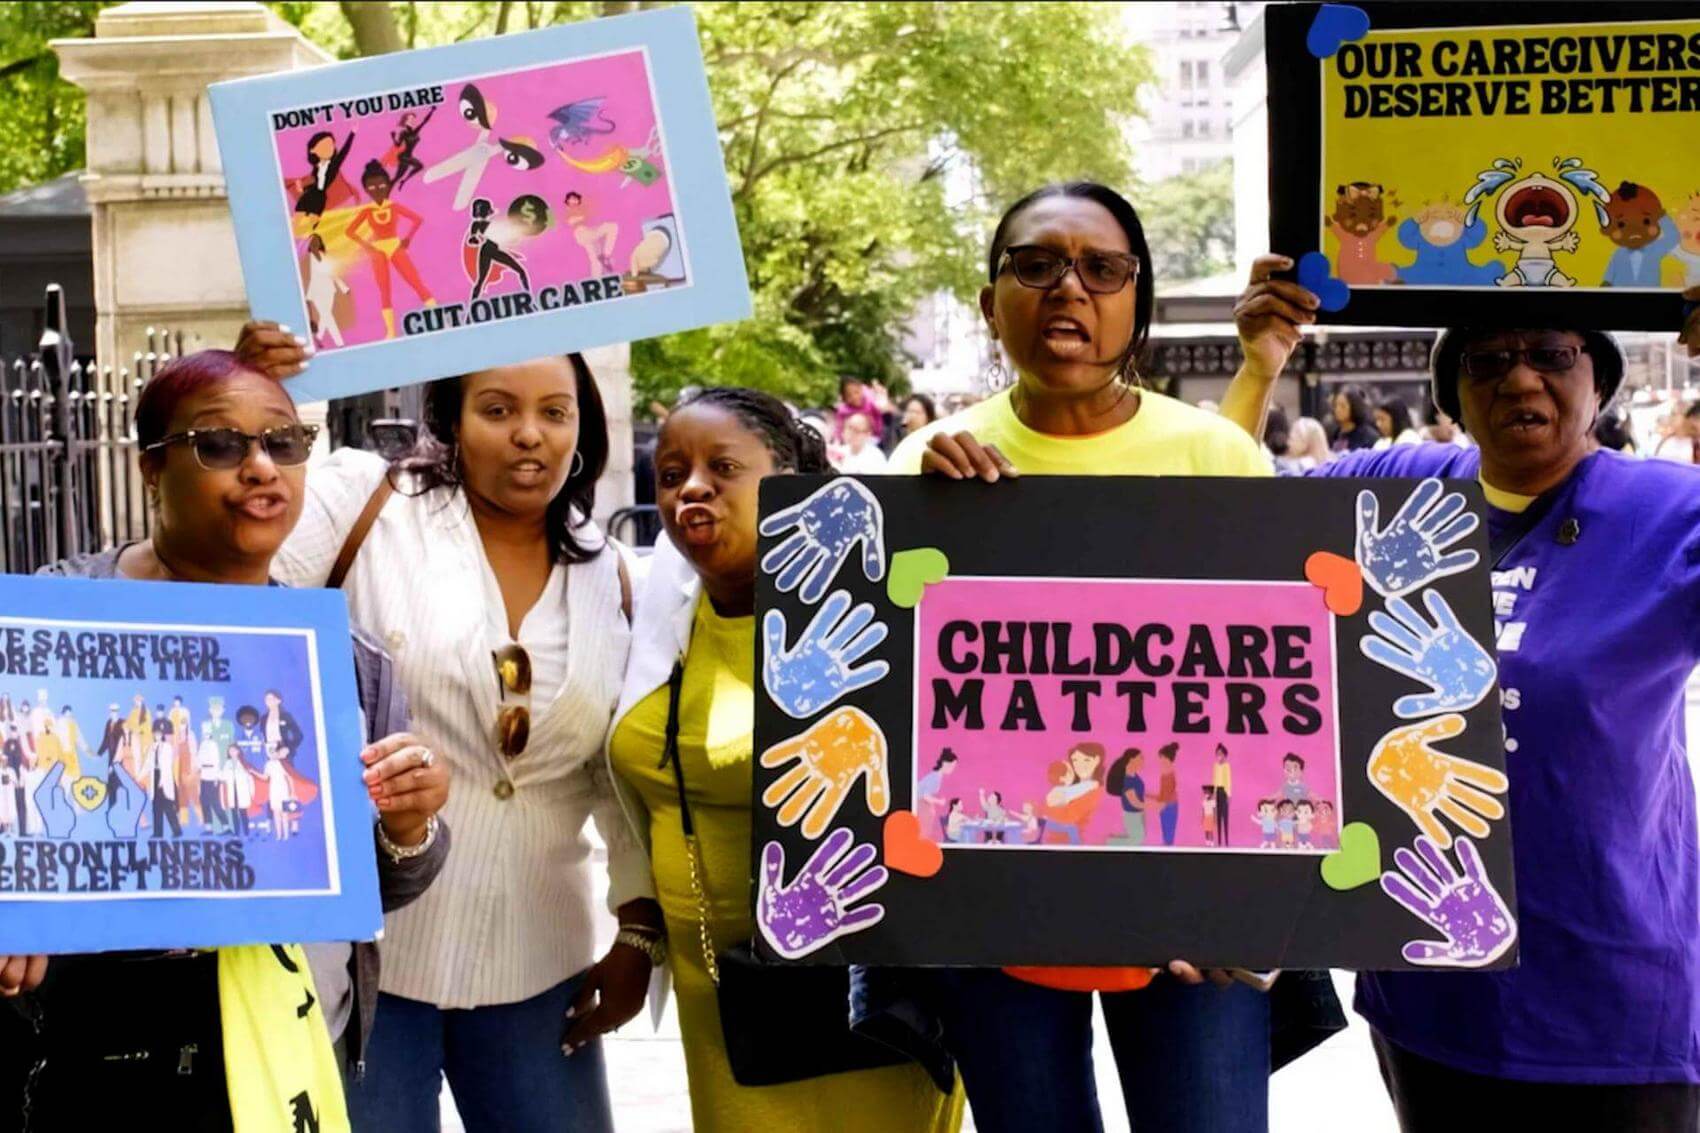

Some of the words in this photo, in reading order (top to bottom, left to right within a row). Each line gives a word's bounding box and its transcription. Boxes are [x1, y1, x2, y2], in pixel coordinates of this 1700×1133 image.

[1336, 41, 1422, 80] OUR
[272, 104, 334, 131] DON'T
[340, 96, 384, 119] YOU
[388, 86, 445, 111] DARE
[1343, 80, 1531, 119] DESERVE
[1540, 76, 1700, 115] BETTER
[403, 304, 464, 337] CUT
[470, 292, 536, 324] OUR
[538, 275, 623, 311] CARE
[32, 629, 220, 659] SACRIFICED
[937, 619, 1313, 679] CHILDCARE
[0, 650, 49, 676] RE
[55, 652, 146, 680] THAN
[152, 655, 231, 682] TIME
[931, 678, 1323, 735] MATTERS
[14, 839, 245, 867] FRONTLINERS
[66, 861, 152, 891] LEFT
[160, 861, 256, 891] BEIND
